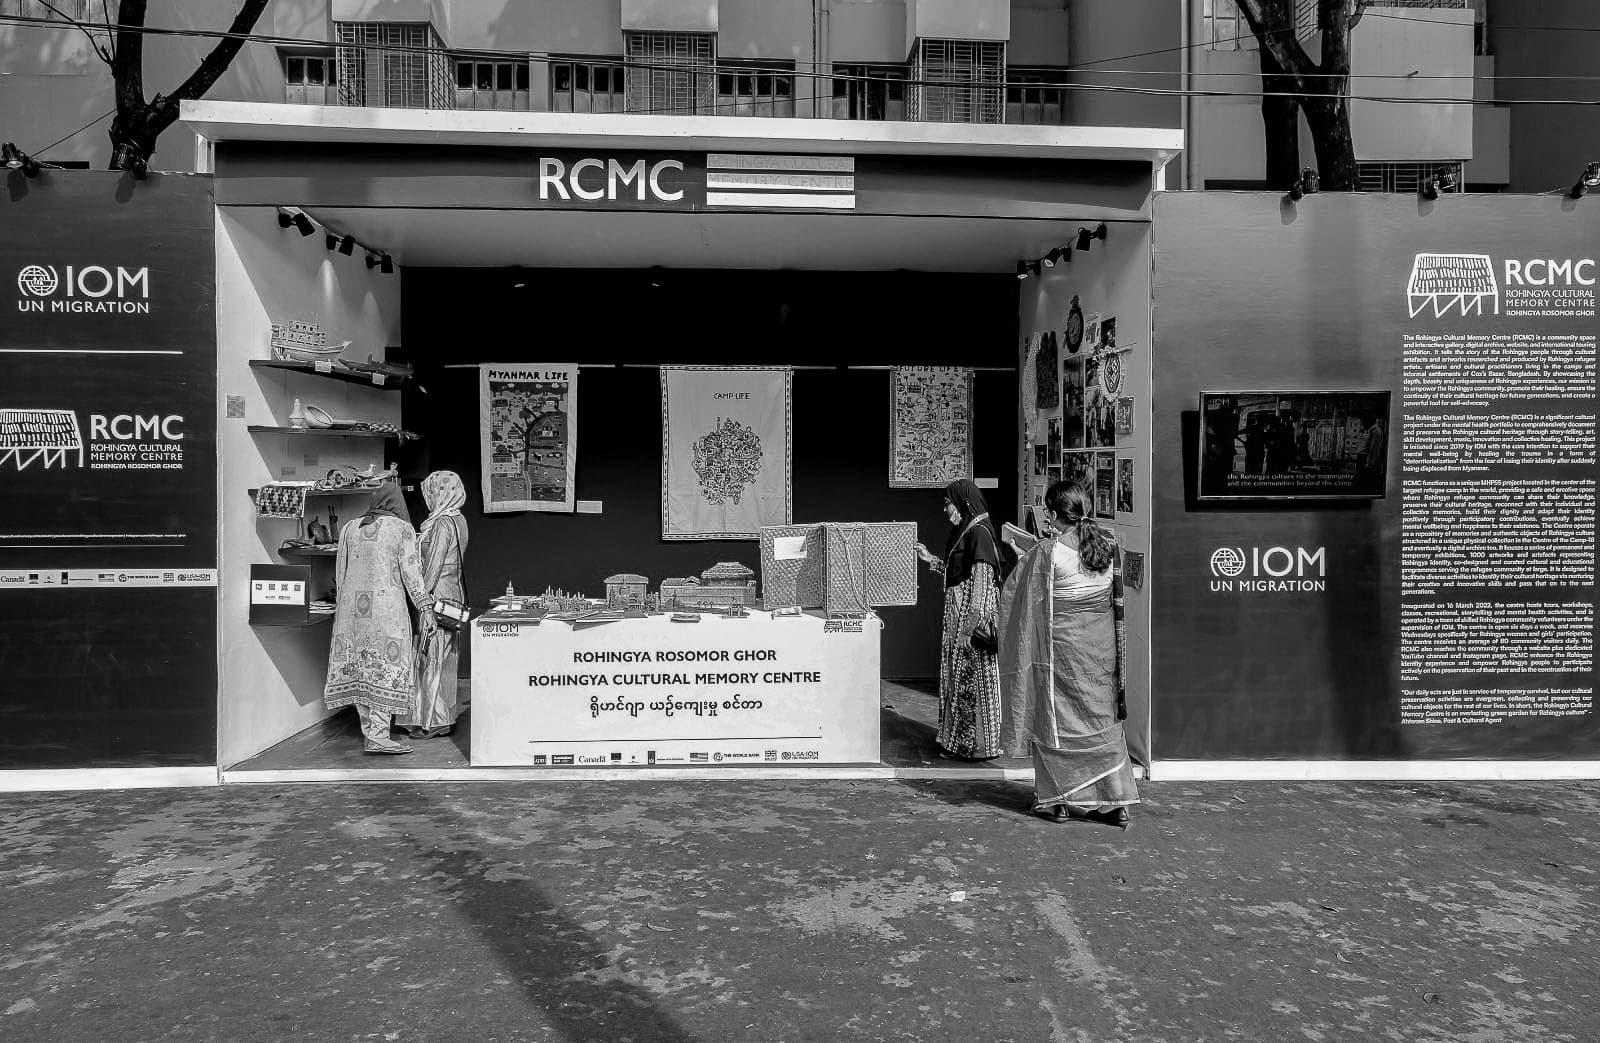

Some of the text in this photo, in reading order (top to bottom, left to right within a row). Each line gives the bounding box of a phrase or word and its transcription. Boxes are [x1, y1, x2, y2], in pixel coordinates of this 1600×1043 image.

[539, 158, 684, 200] RCMC
[1504, 259, 1596, 286] RCMC
[66, 266, 148, 298] IOM
[1506, 290, 1595, 298] ROHINGYA CULTURAL
[18, 300, 149, 314] UN MIGRATION
[1506, 299, 1595, 307] MEMORY CENTRE
[1415, 334, 1441, 342] Rohingya
[1466, 334, 1490, 342] Memory
[1512, 334, 1534, 342] (RCMC)
[1547, 334, 1578, 342] community
[1466, 348, 1480, 356] story
[1502, 348, 1528, 356] Rohingya
[1530, 348, 1549, 356] people
[1551, 348, 1573, 356] through
[488, 370, 568, 380] MYANMAR LIFE
[714, 392, 751, 400] CAMP LIFE
[90, 414, 184, 440] RCMC
[91, 444, 183, 452] ROHINGYA CULTURAL
[1429, 450, 1458, 458] well-being
[1253, 547, 1325, 576] IOM
[1210, 580, 1325, 591] UN MIGRATION
[496, 624, 519, 632] IOM
[573, 650, 777, 663] ROHINGYA ROSOMOR GHOR
[528, 672, 821, 686] ROHINGYA CULTURAL MEMORY CENTRE
